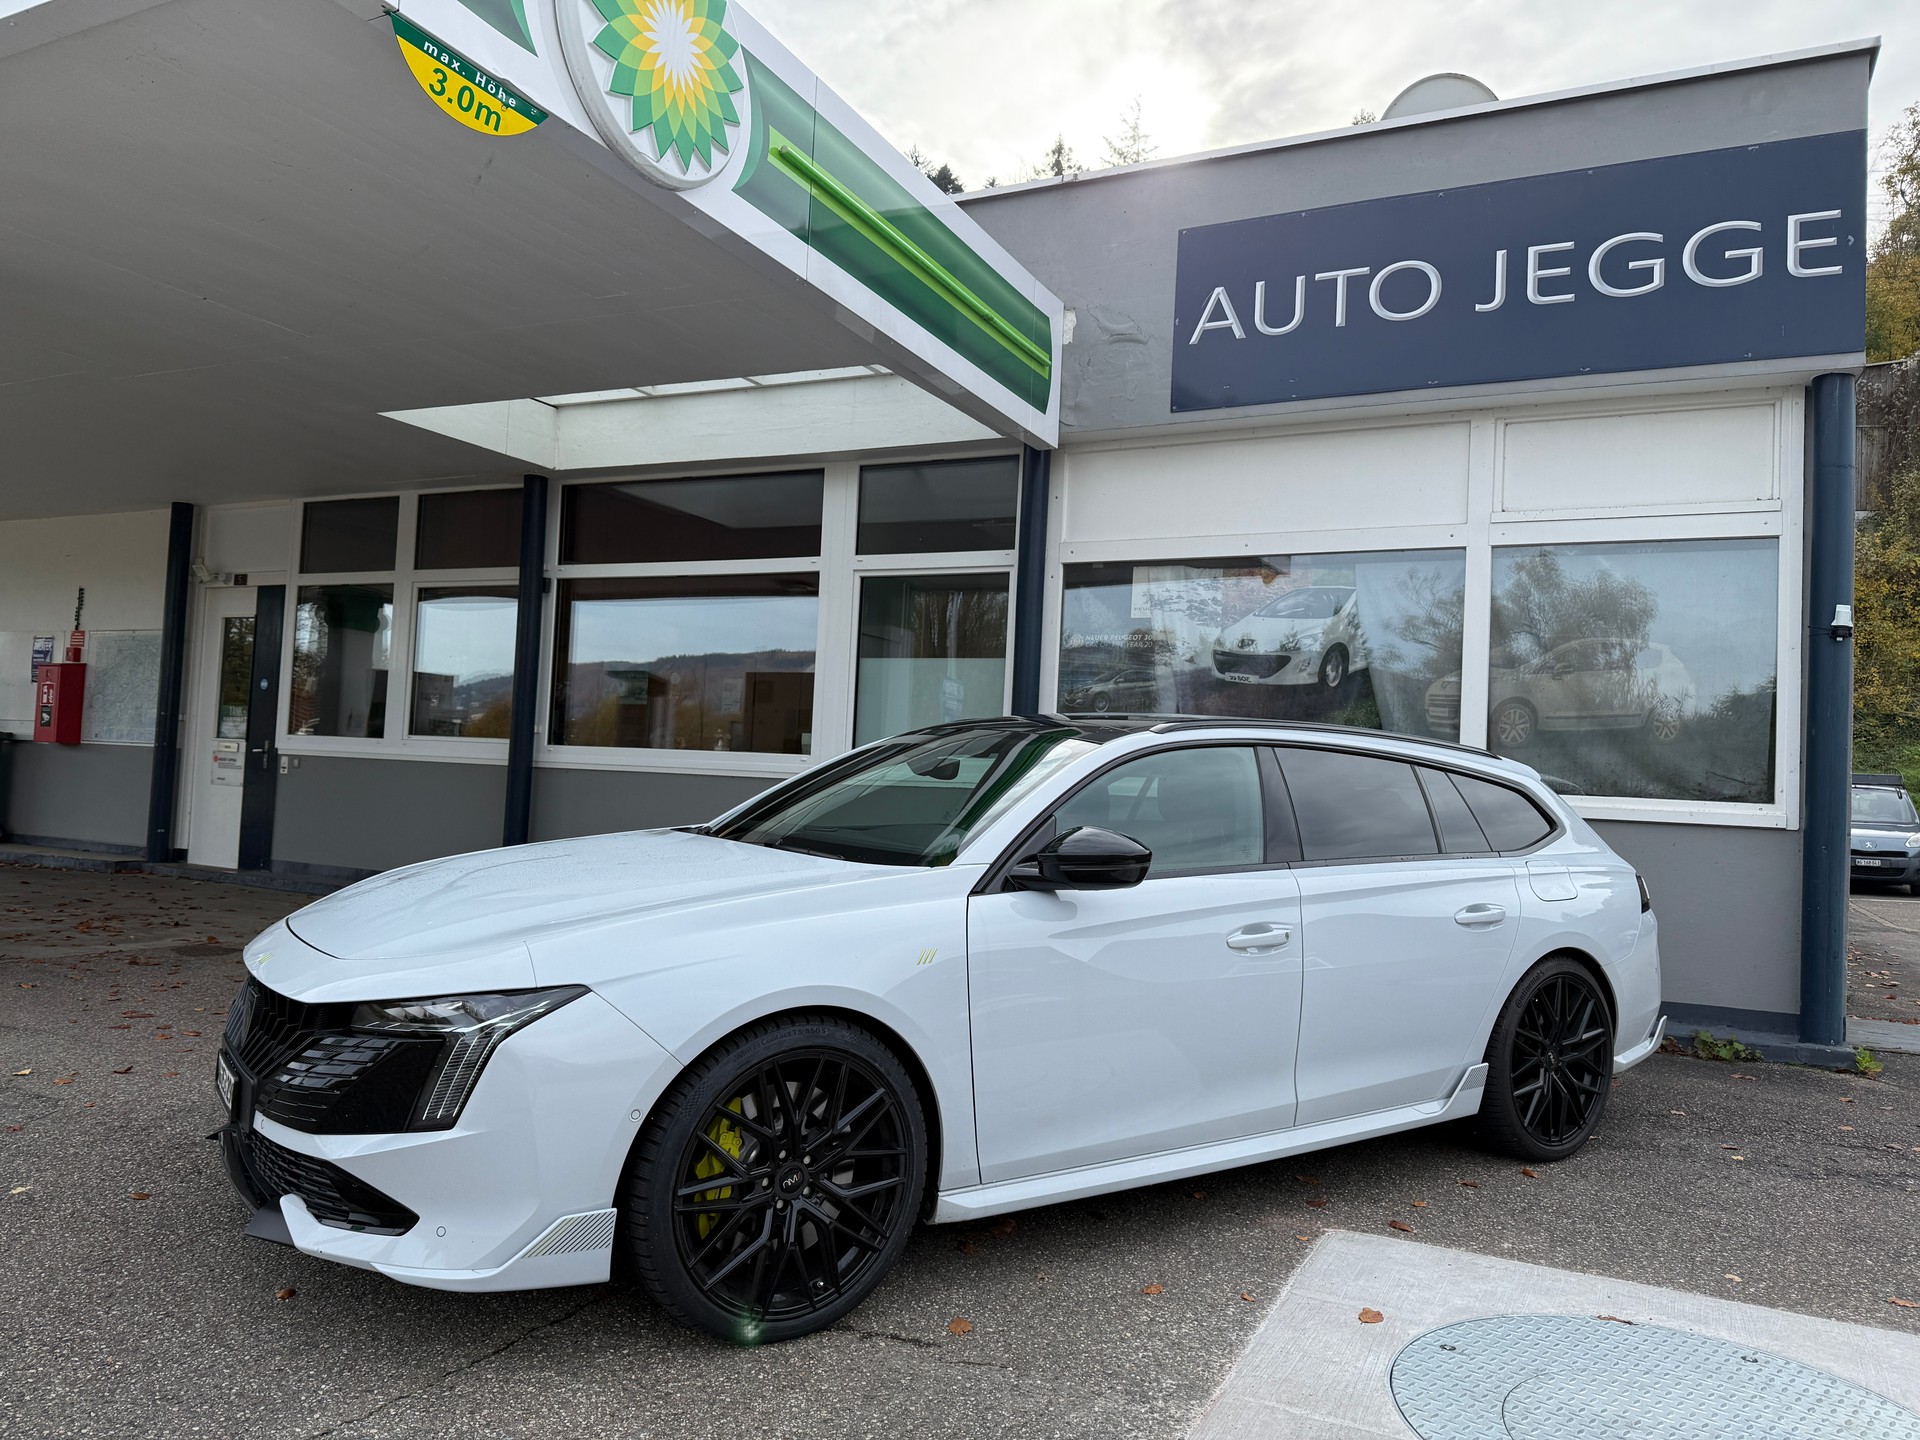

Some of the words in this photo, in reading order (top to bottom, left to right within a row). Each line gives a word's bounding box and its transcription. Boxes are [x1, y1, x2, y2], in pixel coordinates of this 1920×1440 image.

[423, 41, 465, 75] max.
[475, 72, 516, 107] Höhe
[429, 67, 501, 132] 3.0m
[1189, 259, 1443, 345] AUTO
[1475, 209, 1843, 313] JEGGE
